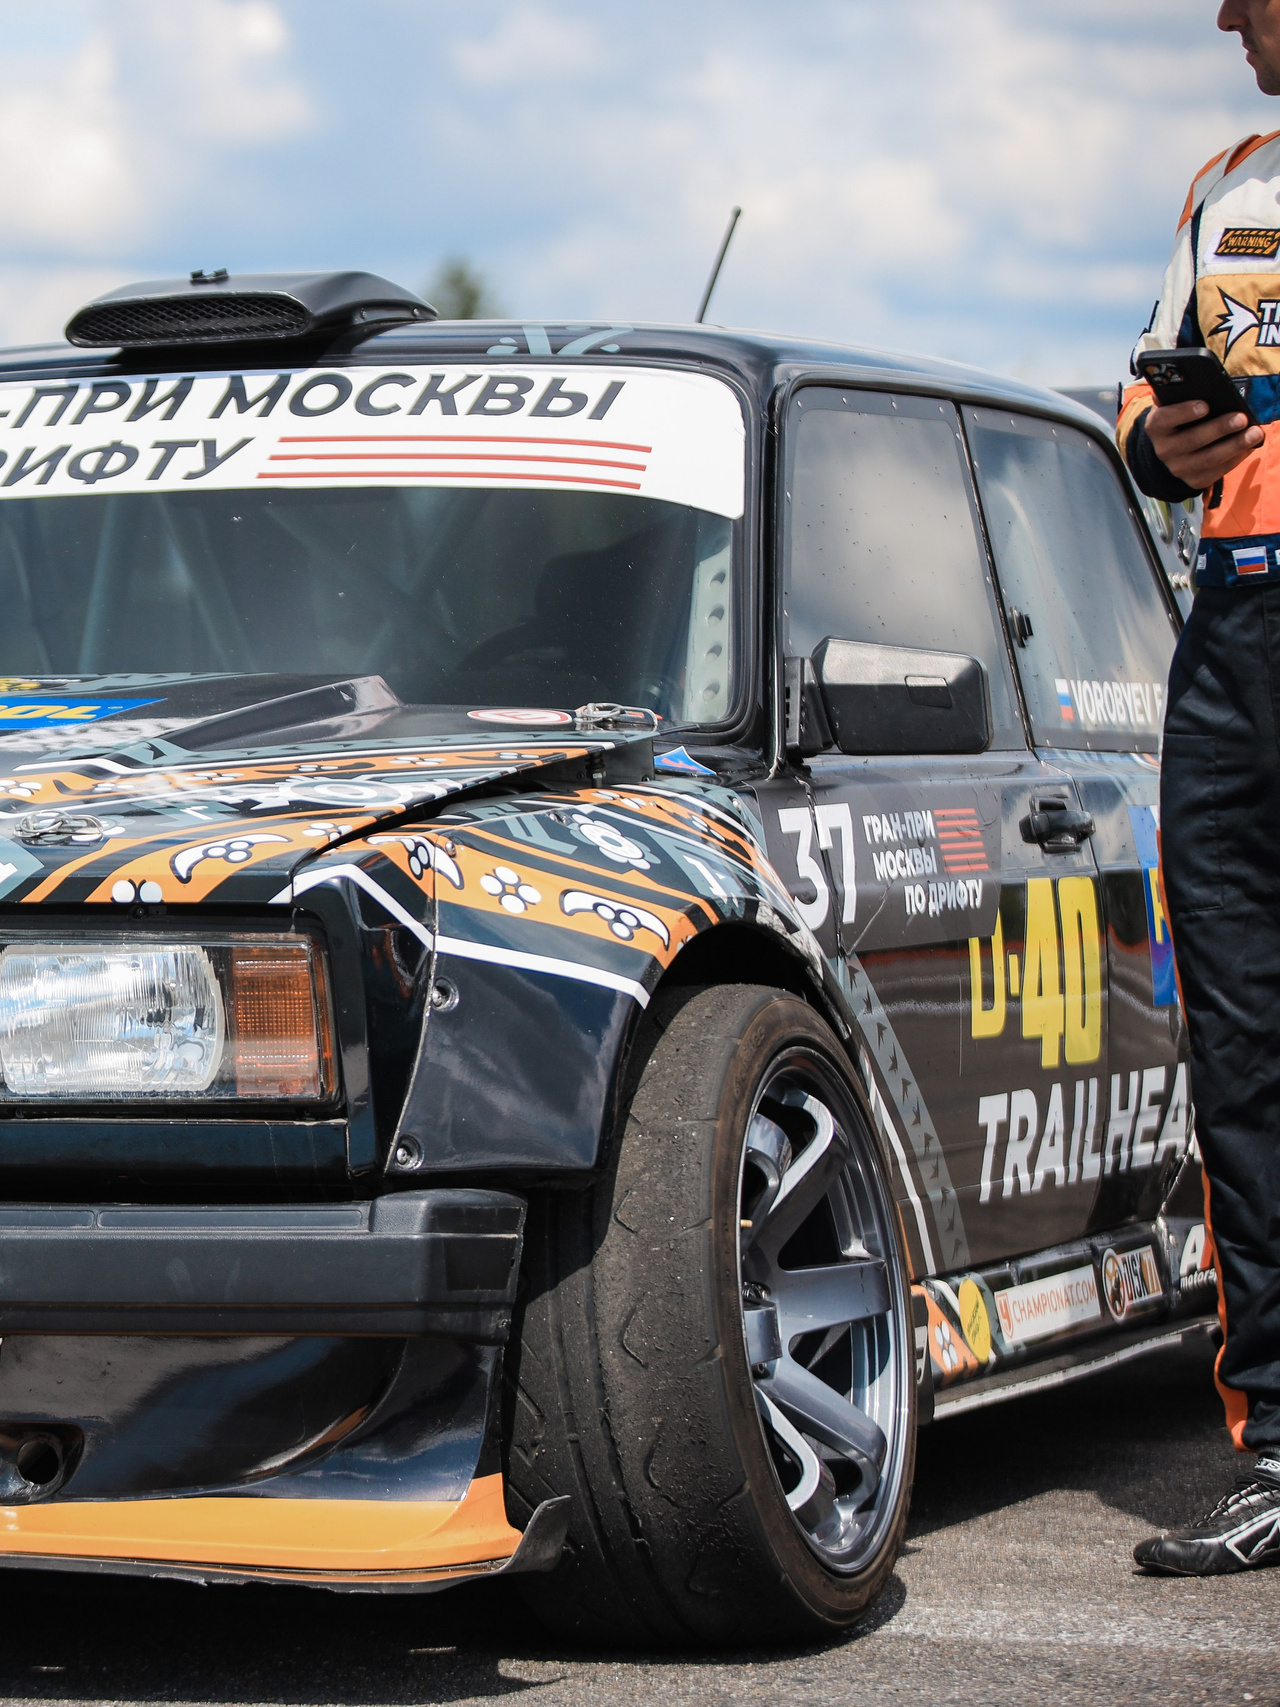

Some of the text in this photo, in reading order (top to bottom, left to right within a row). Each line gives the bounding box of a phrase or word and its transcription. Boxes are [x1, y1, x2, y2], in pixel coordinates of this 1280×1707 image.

[1228, 235, 1273, 248] WARNING
[209, 372, 627, 421] МОСКВЫ
[1070, 679, 1152, 724] VOROBYEV
[862, 809, 936, 845] ГРАН-ПРИ
[777, 802, 857, 931] 37
[872, 846, 938, 881] МОСКВЫ
[904, 878, 984, 918] ПО ДРИФТУ
[977, 1062, 1202, 1205] TRAILHEA
[1012, 1277, 1098, 1323] CHAMPIONAT.COM
